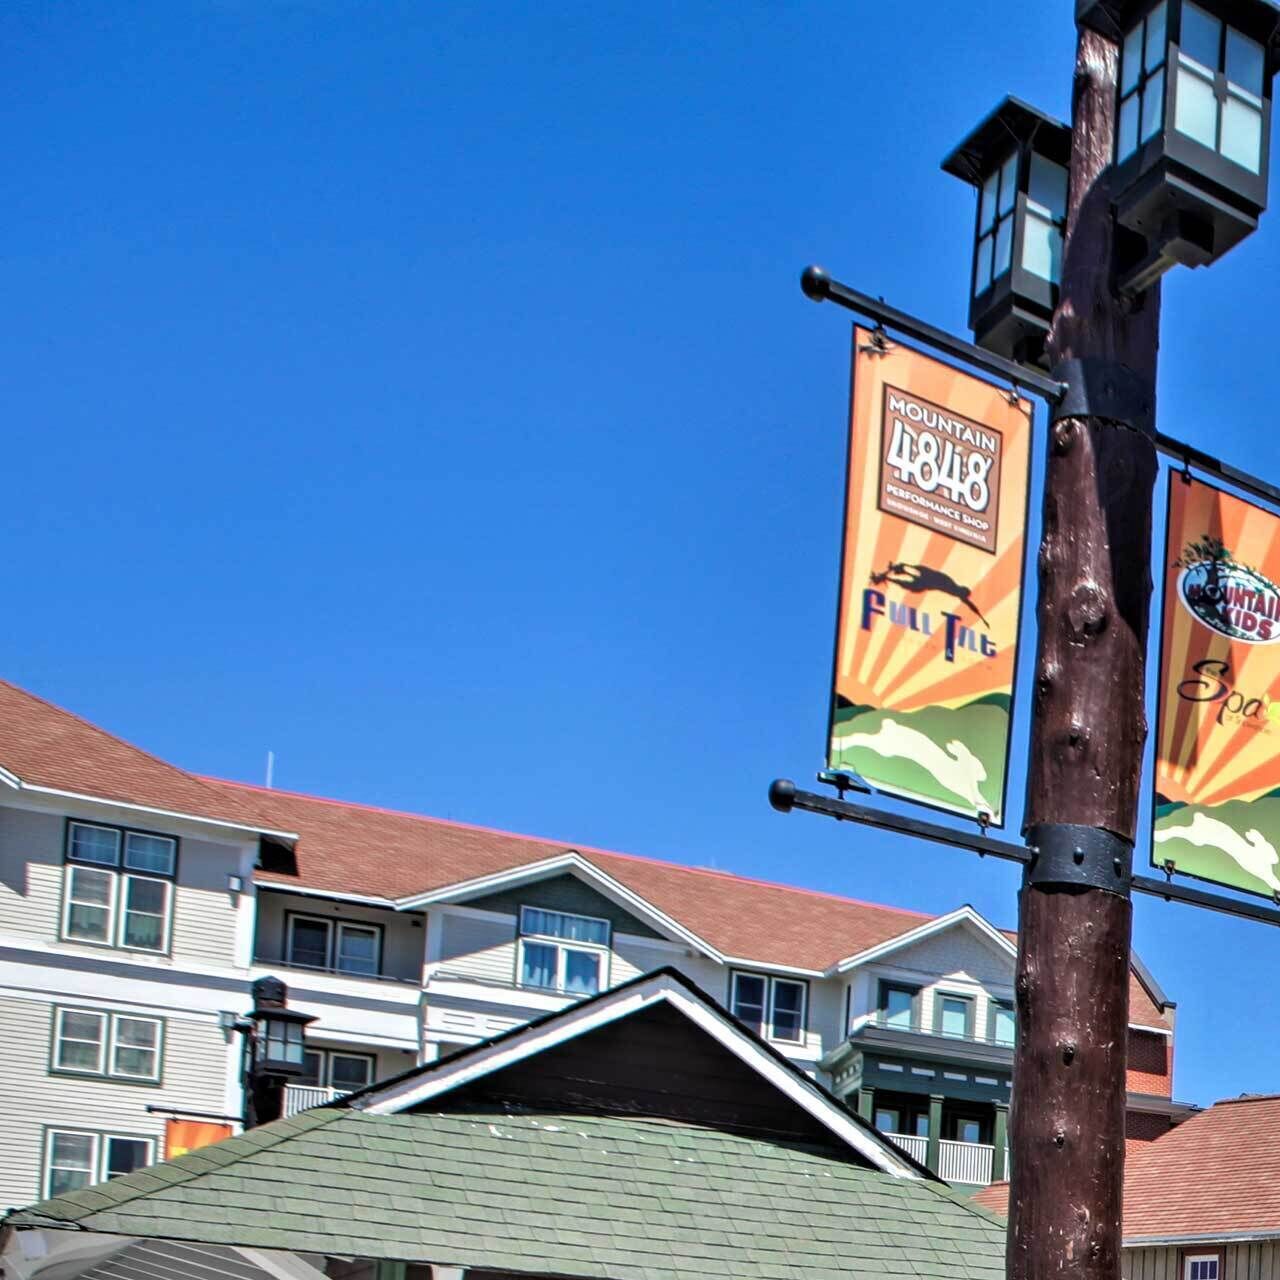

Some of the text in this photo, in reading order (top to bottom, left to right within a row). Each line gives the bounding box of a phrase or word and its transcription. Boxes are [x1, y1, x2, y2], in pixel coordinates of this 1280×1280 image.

[888, 394, 996, 454] MOUNTAIN
[887, 417, 994, 513] 4848
[886, 484, 961, 521] PERFORMANCE
[961, 513, 990, 531] SHOP
[1224, 606, 1273, 641] KIDS
[1177, 659, 1263, 727] Spa
